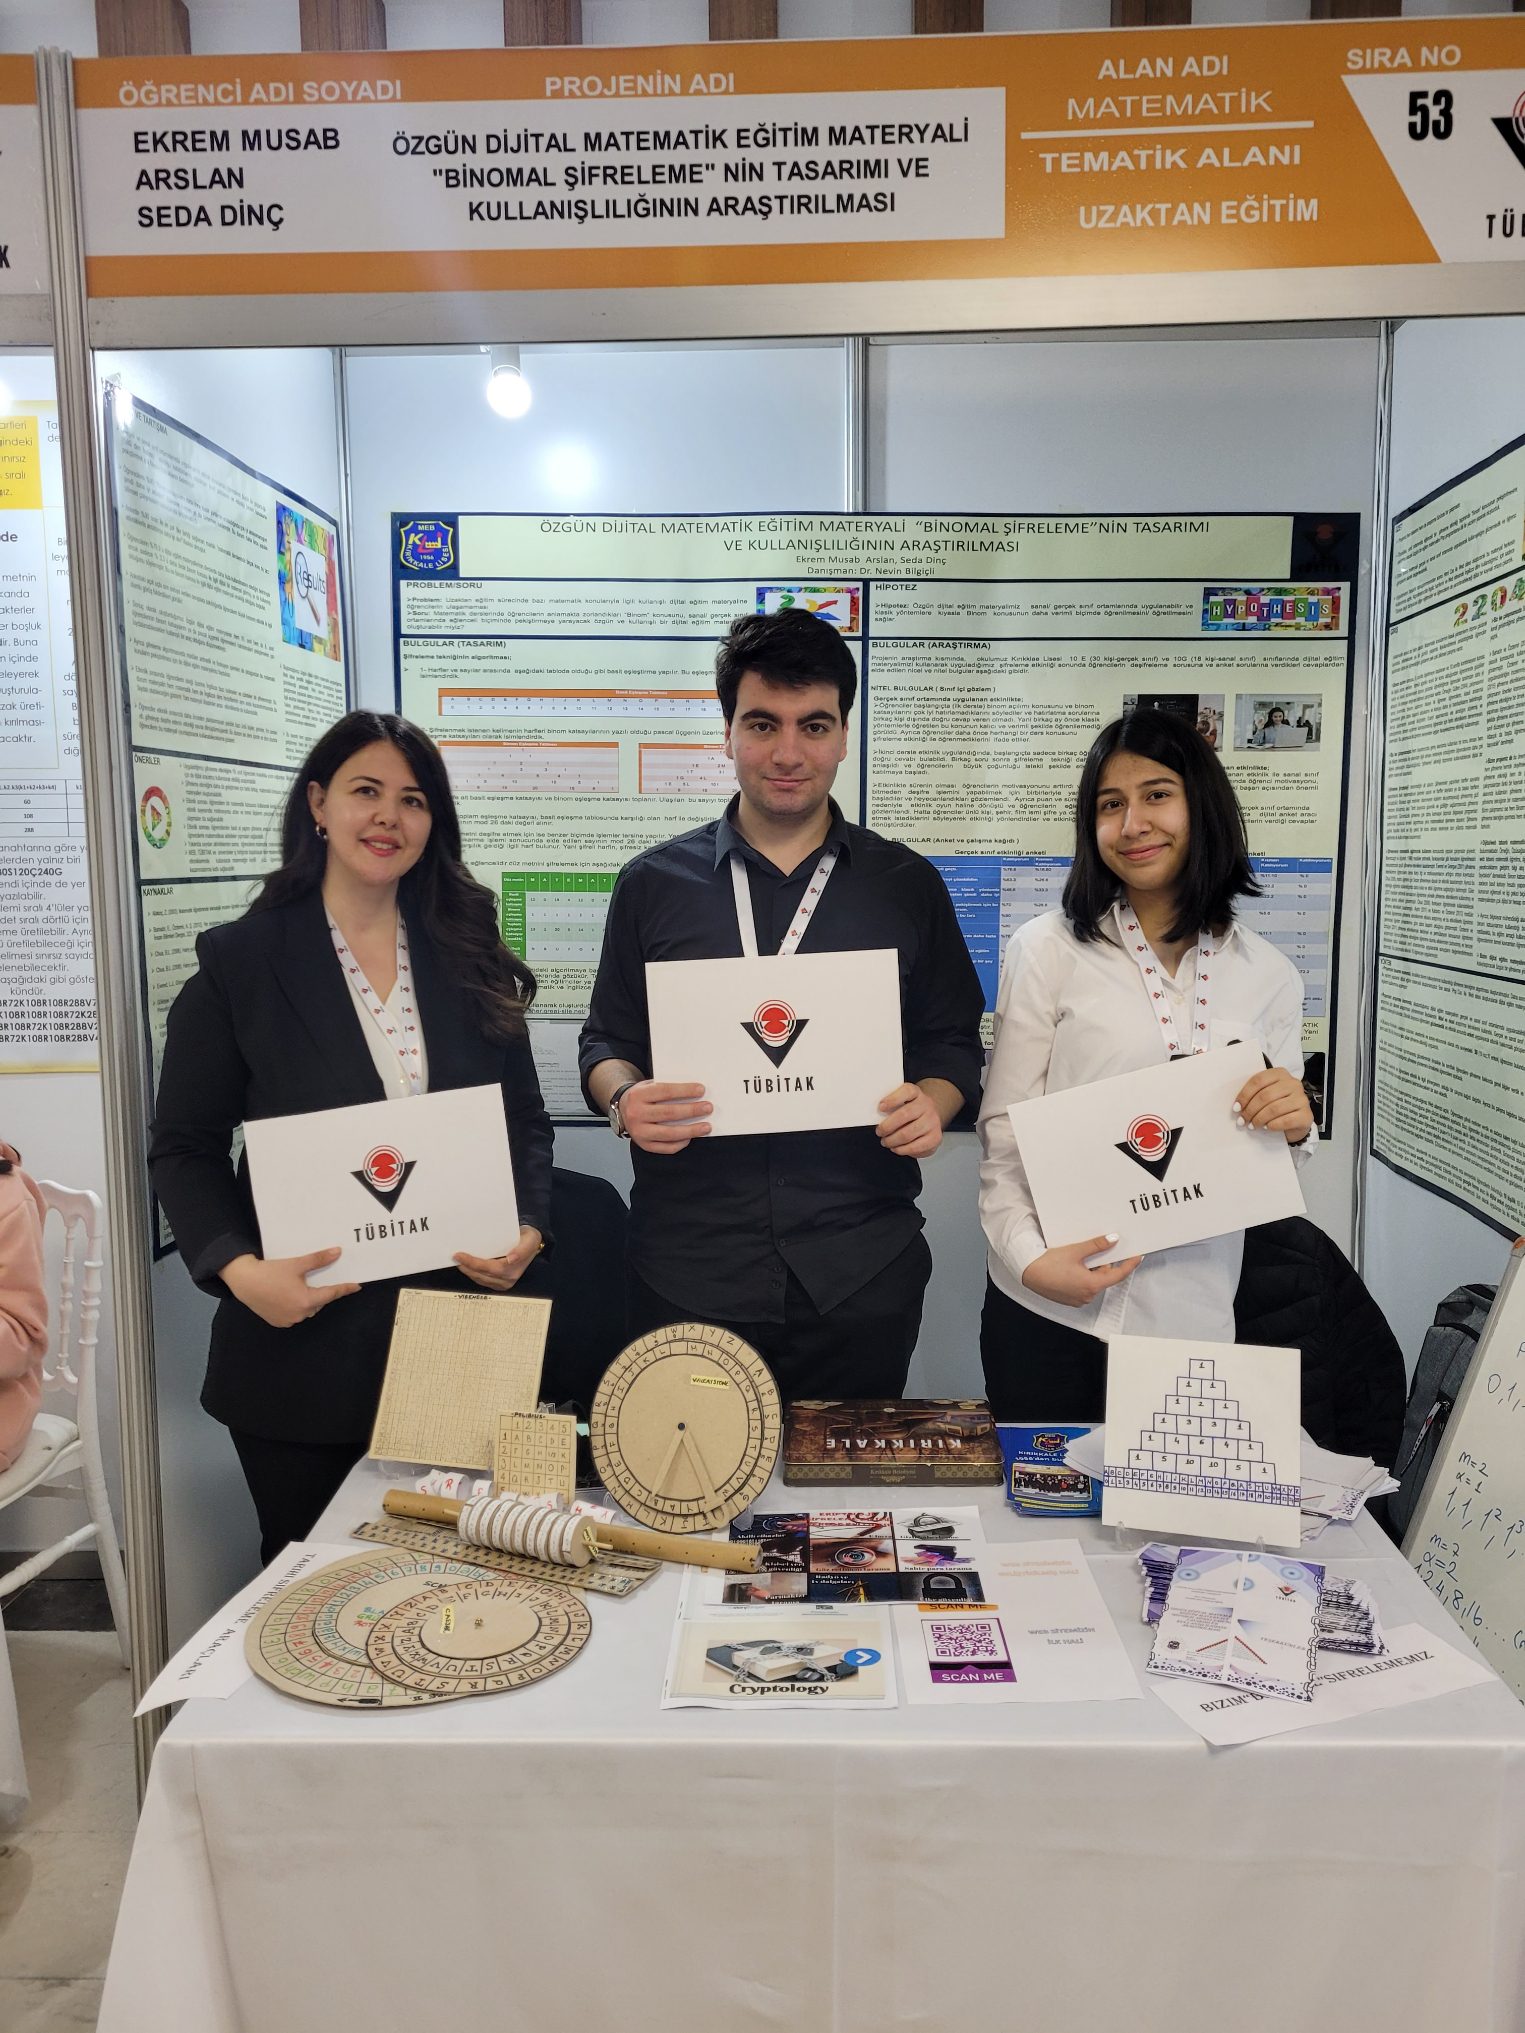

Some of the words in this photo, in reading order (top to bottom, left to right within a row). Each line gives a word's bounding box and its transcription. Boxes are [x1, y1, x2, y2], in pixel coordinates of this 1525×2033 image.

[1347, 47, 1412, 69] SIRA
[1421, 45, 1461, 66] NO
[1098, 57, 1173, 80] ALAN
[1181, 55, 1228, 77] ADI
[545, 71, 680, 97] PROJENİN
[689, 73, 734, 95] ADI
[119, 78, 241, 106] ÖĞRENCİ
[249, 82, 294, 103] ADI
[303, 80, 401, 102] SOYADI
[1068, 88, 1272, 121] MATEMATİK
[1408, 89, 1453, 141] 53
[134, 130, 230, 153] EKREM
[242, 128, 340, 151] MUSAB
[393, 130, 476, 155] ÖZGÜN
[486, 128, 576, 154] DİJİTAL
[584, 124, 728, 152] MATEMATİK
[737, 122, 819, 148] EĞİTİM
[829, 117, 968, 146] MATERYALİ
[1039, 145, 1188, 173] TEMATİK
[1196, 145, 1300, 168] ALANI
[724, 157, 763, 182] NİN
[772, 159, 888, 181] TASARIMI
[897, 158, 929, 178] VE
[136, 167, 244, 190] ARSLAN
[469, 193, 699, 224] KULLANIŞLILIĞININ
[707, 192, 894, 220] ARAŞTIRILMASI
[1080, 202, 1210, 232] UZAKTAN
[1221, 193, 1318, 224] EĞİTİM
[138, 205, 212, 228] SEDA
[221, 200, 284, 231] DİNÇ
[1486, 208, 1525, 238] TÜ
[541, 520, 596, 532] ÖZGÜN
[603, 520, 656, 533] DİJİTAL
[662, 519, 752, 533] MATEMATİK
[759, 518, 813, 531] EĞİTİM
[820, 519, 905, 532] MATERYALİ
[1133, 522, 1209, 533] TASARIMI
[0, 531, 18, 542] de
[724, 540, 742, 551] VE
[749, 537, 894, 552] KULLANIŞLILIĞININ
[900, 540, 1018, 553] ARAŞTIRILMASI
[865, 556, 897, 565] Arslan,
[926, 557, 946, 565] Dinç
[2, 573, 37, 582] metnin
[808, 567, 856, 575] Danışman:
[905, 568, 934, 576] Bilgiçli
[875, 582, 918, 591] HİPOTEZ
[1212, 601, 1329, 618] HYPOTHESIS
[12, 622, 42, 632] boşluk
[14, 638, 38, 646] Buna
[928, 641, 991, 650] (ARAŞTIRMA)
[9, 654, 38, 664] içinde
[54, 843, 77, 854] göre
[37, 856, 64, 866] yalnız
[67, 856, 81, 864] biri
[21, 880, 52, 890] içinde
[55, 880, 64, 888] de
[71, 881, 86, 890] yer
[23, 904, 43, 912] sıralı
[20, 916, 40, 924] sıralı
[42, 915, 69, 924] dörtlü
[72, 916, 88, 925] için
[20, 927, 69, 936] üretilebilir.
[6, 939, 75, 949] üretilebileceği
[35, 951, 62, 960] sınırsız
[1, 975, 47, 986] aşağıdaki
[50, 975, 66, 986] gibi
[10, 987, 45, 996] kündür.
[743, 1074, 815, 1094] TÜBİTAK
[1129, 1183, 1205, 1214] TÜBİTAK
[354, 1216, 430, 1243] TÜBİTAK
[826, 1438, 962, 1449] KIRIKKALE
[1174, 1436, 1180, 1445] 4
[1224, 1441, 1230, 1449] 4
[1161, 1455, 1168, 1463] 5
[941, 1673, 980, 1681] SCAN
[983, 1672, 1004, 1681] ME
[729, 1682, 829, 1696] Cryptology
